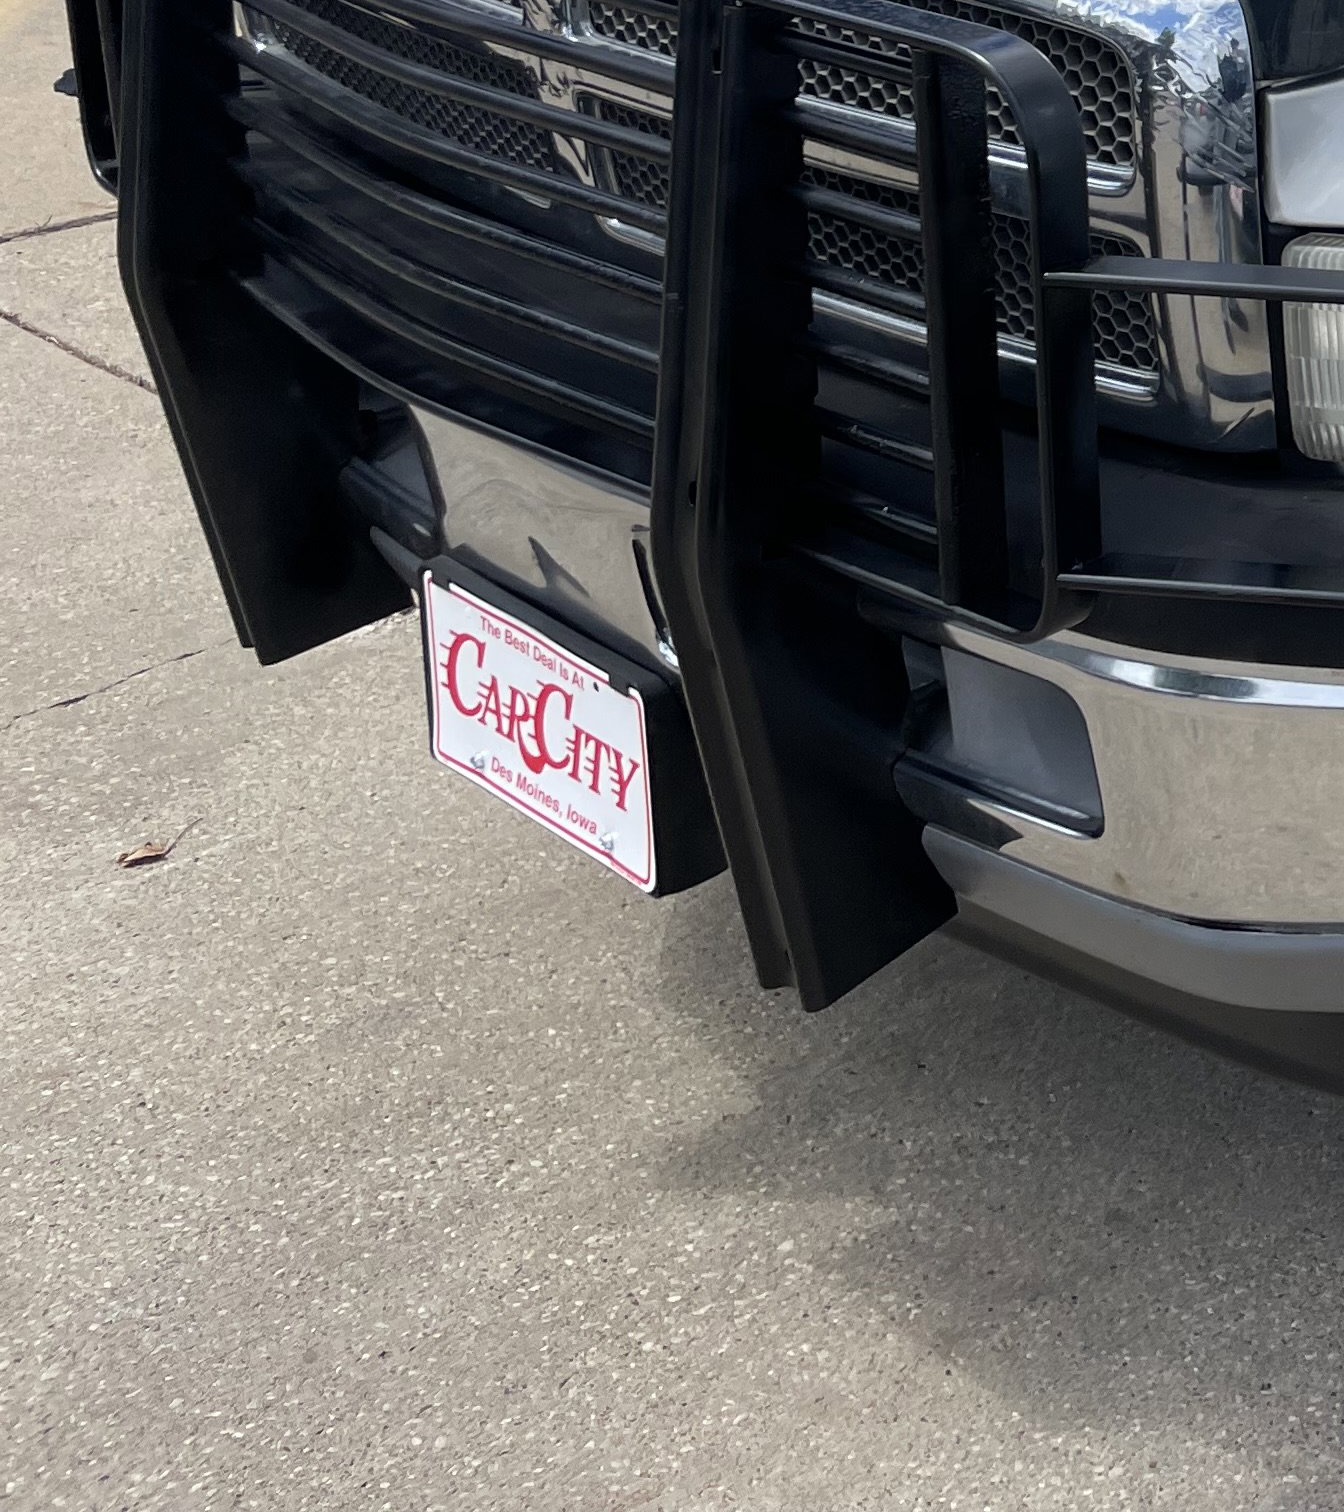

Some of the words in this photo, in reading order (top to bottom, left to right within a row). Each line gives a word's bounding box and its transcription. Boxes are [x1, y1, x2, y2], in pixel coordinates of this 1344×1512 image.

[480, 615, 500, 640] The
[504, 629, 531, 657] Best
[533, 646, 557, 673] Deal
[559, 661, 569, 682] Is
[572, 671, 585, 691] At
[490, 756, 513, 784] Des
[516, 777, 563, 819] Moines,
[566, 804, 598, 835] Iowa
